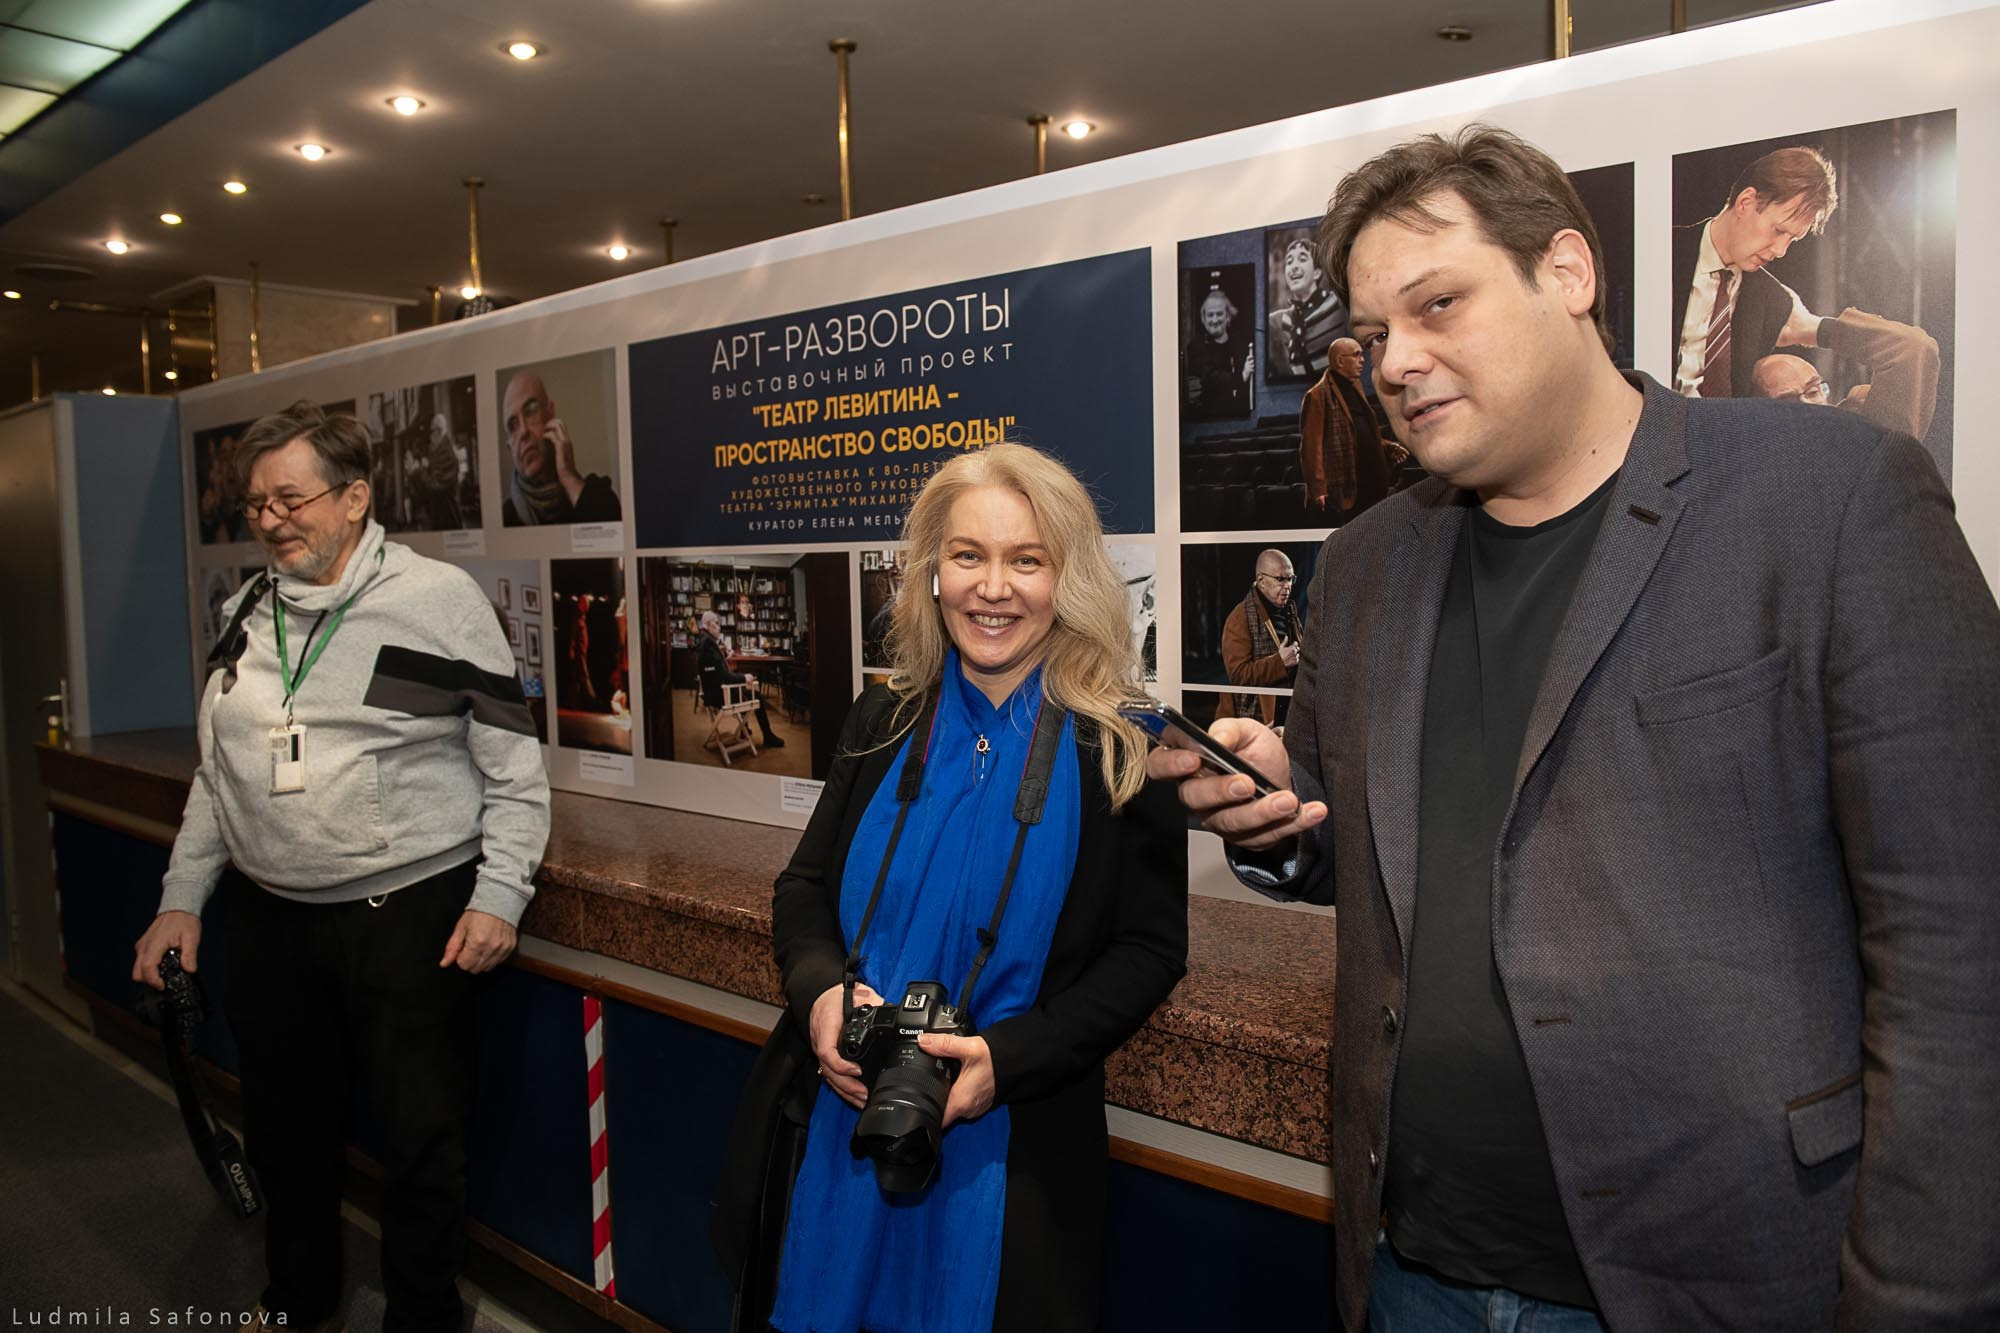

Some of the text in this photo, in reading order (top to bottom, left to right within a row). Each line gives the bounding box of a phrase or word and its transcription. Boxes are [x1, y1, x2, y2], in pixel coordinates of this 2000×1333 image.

[711, 288, 1010, 374] АРТ-РАЗВОРОТЫ
[712, 343, 1013, 400] выставочный проект
[753, 400, 819, 428] "ТЕАТР
[823, 384, 941, 421] ЛЕВИТИНА
[714, 415, 1015, 468] ПРОСТРАНСТВО СВОБОДЫ"
[752, 467, 860, 485] ФОТОВЫСТАВКА
[868, 466, 875, 477] К
[730, 482, 862, 500] ХУДОЖЕСТВЕННОГО
[720, 502, 764, 514] ТЕАТРА
[749, 519, 804, 531] КУРАТОР
[812, 517, 855, 529] ЕЛЕНА
[899, 1027, 924, 1035] Canon
